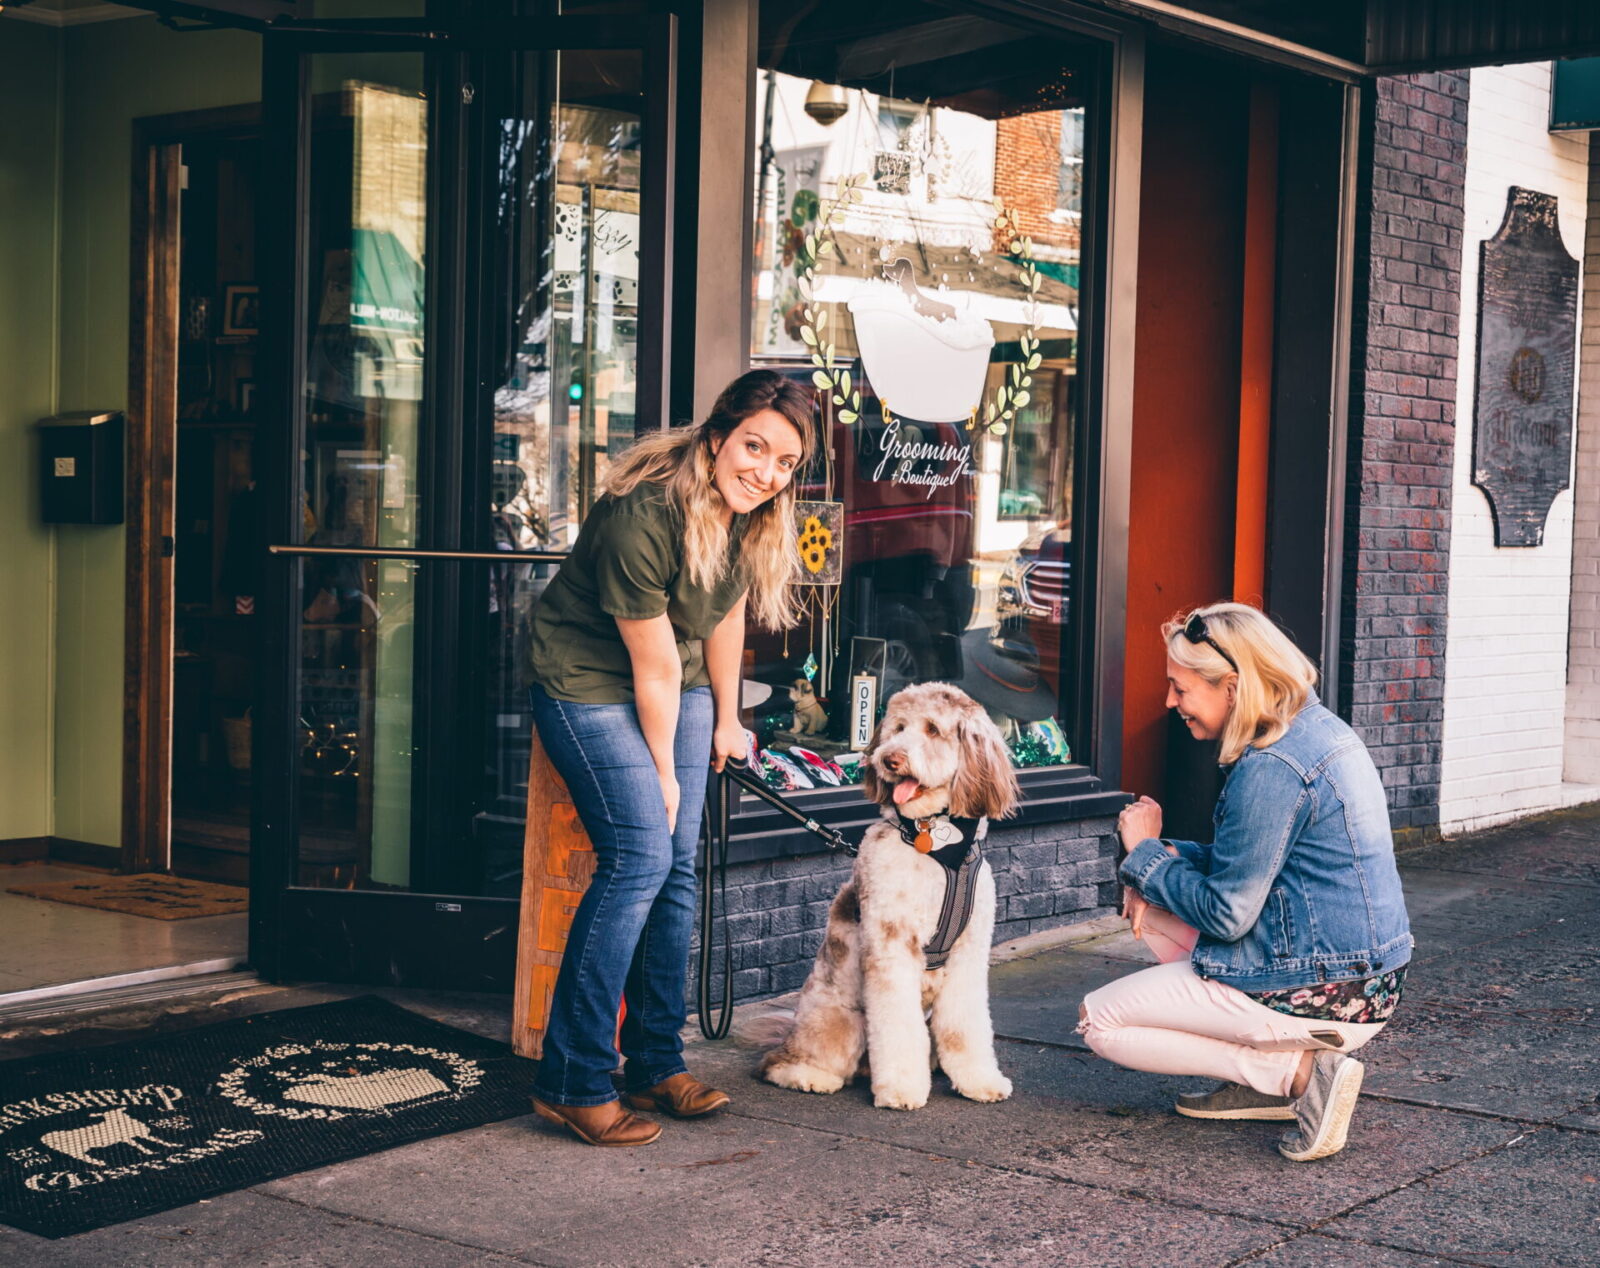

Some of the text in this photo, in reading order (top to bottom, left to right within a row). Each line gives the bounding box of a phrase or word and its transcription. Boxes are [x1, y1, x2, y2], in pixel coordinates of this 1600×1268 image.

[873, 418, 970, 485] Grooming
[899, 460, 950, 500] Boutique
[858, 686, 869, 742] OPEN
[527, 757, 594, 1030] PEN
[45, 1084, 184, 1112] SHEEP
